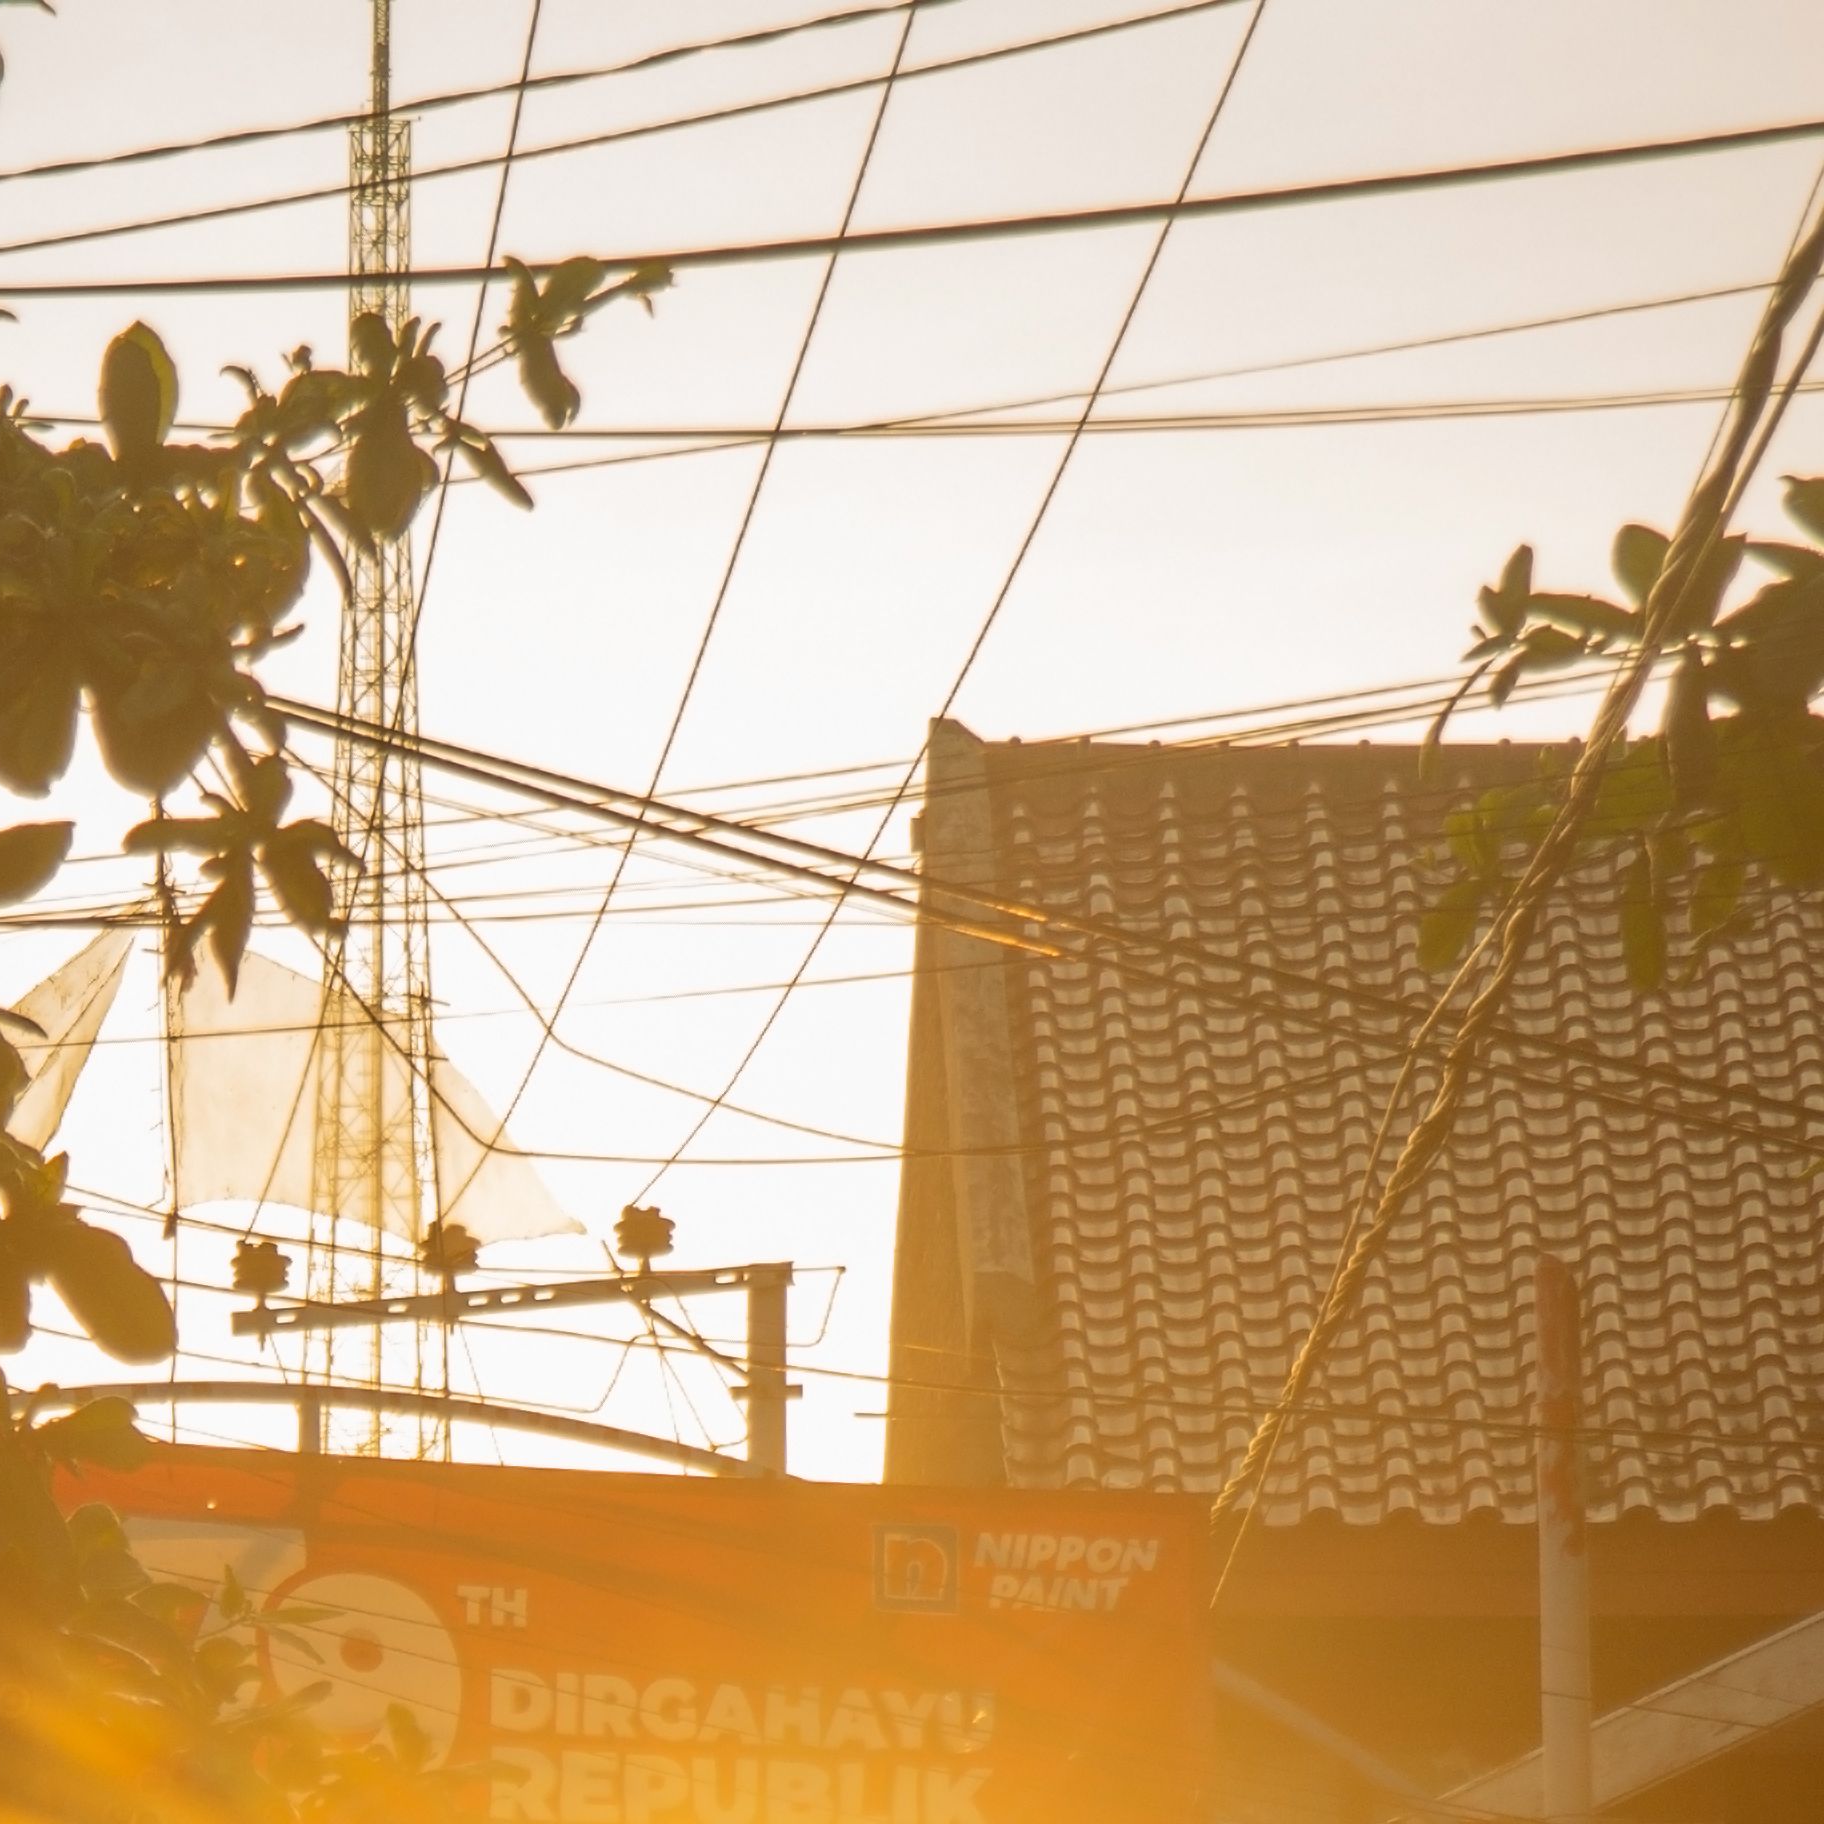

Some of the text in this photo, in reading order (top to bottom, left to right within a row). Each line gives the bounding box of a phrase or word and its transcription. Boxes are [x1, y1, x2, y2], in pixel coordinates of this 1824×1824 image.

[972, 1532, 1161, 1573] NIPPON
[456, 1584, 529, 1630] TH
[988, 1573, 1130, 1612] PAINT
[488, 1668, 997, 1755] DIRGAHAYU
